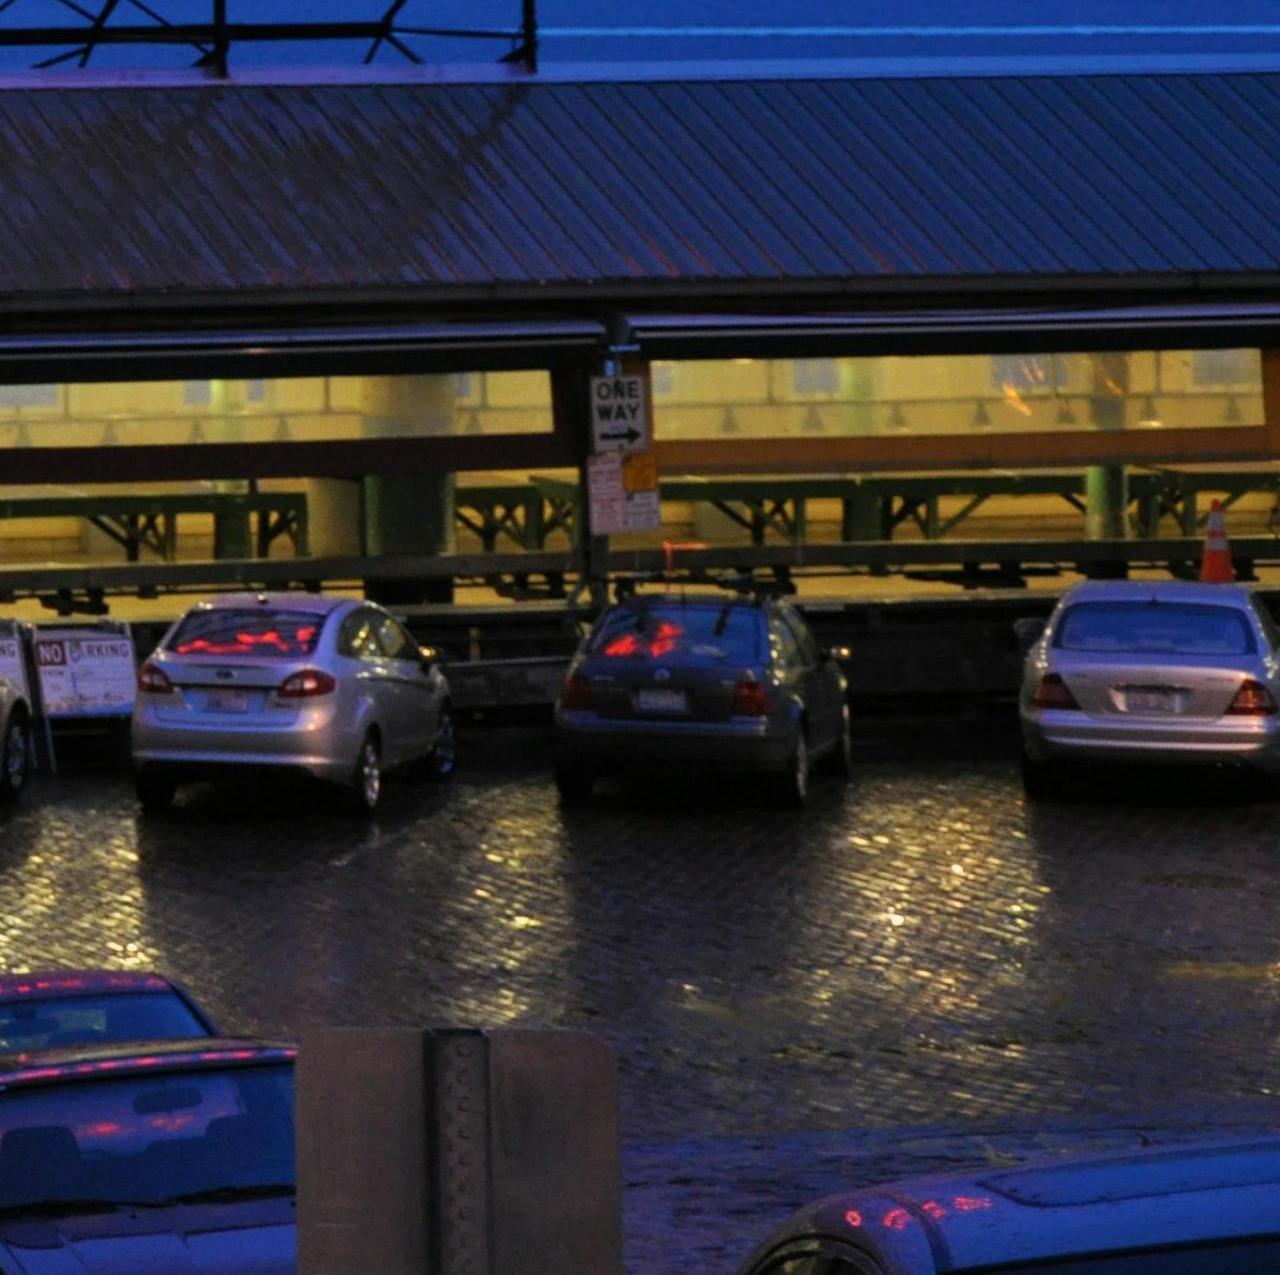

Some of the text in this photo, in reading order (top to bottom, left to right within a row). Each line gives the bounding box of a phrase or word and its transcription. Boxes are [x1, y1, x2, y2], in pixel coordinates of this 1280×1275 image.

[597, 381, 639, 400] ONE
[597, 405, 640, 421] WAY
[39, 642, 62, 663] NO
